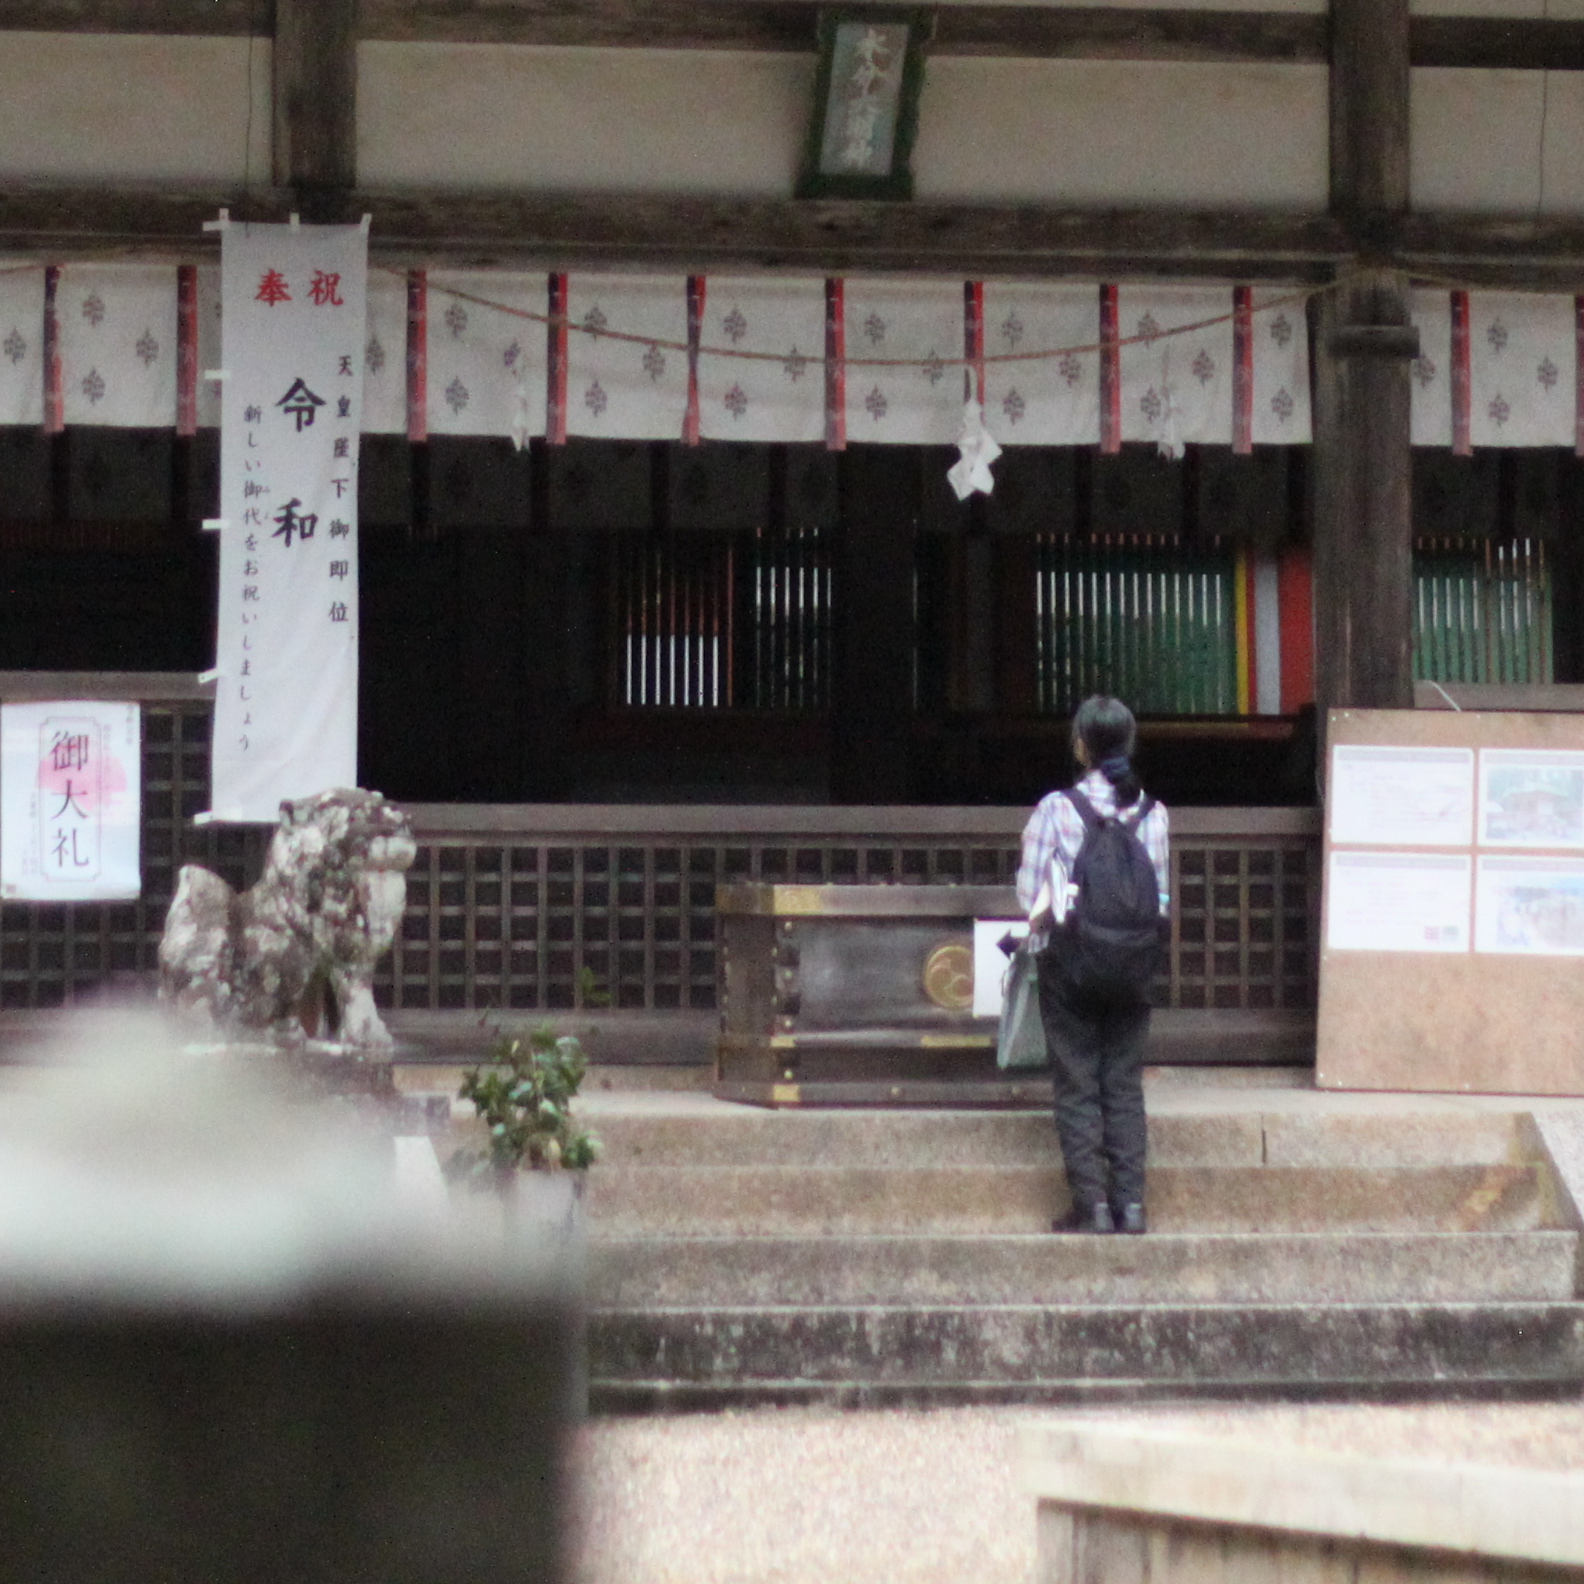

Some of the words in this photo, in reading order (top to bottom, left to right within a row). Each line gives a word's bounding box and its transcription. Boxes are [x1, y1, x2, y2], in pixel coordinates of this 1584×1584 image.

[253, 268, 344, 307] 奉祝
[271, 377, 326, 548] 令和
[328, 354, 354, 623] 天皇陛下御即位
[238, 404, 262, 751] 新しい御代をお祝いしましょう
[49, 729, 90, 868] 御大礼
